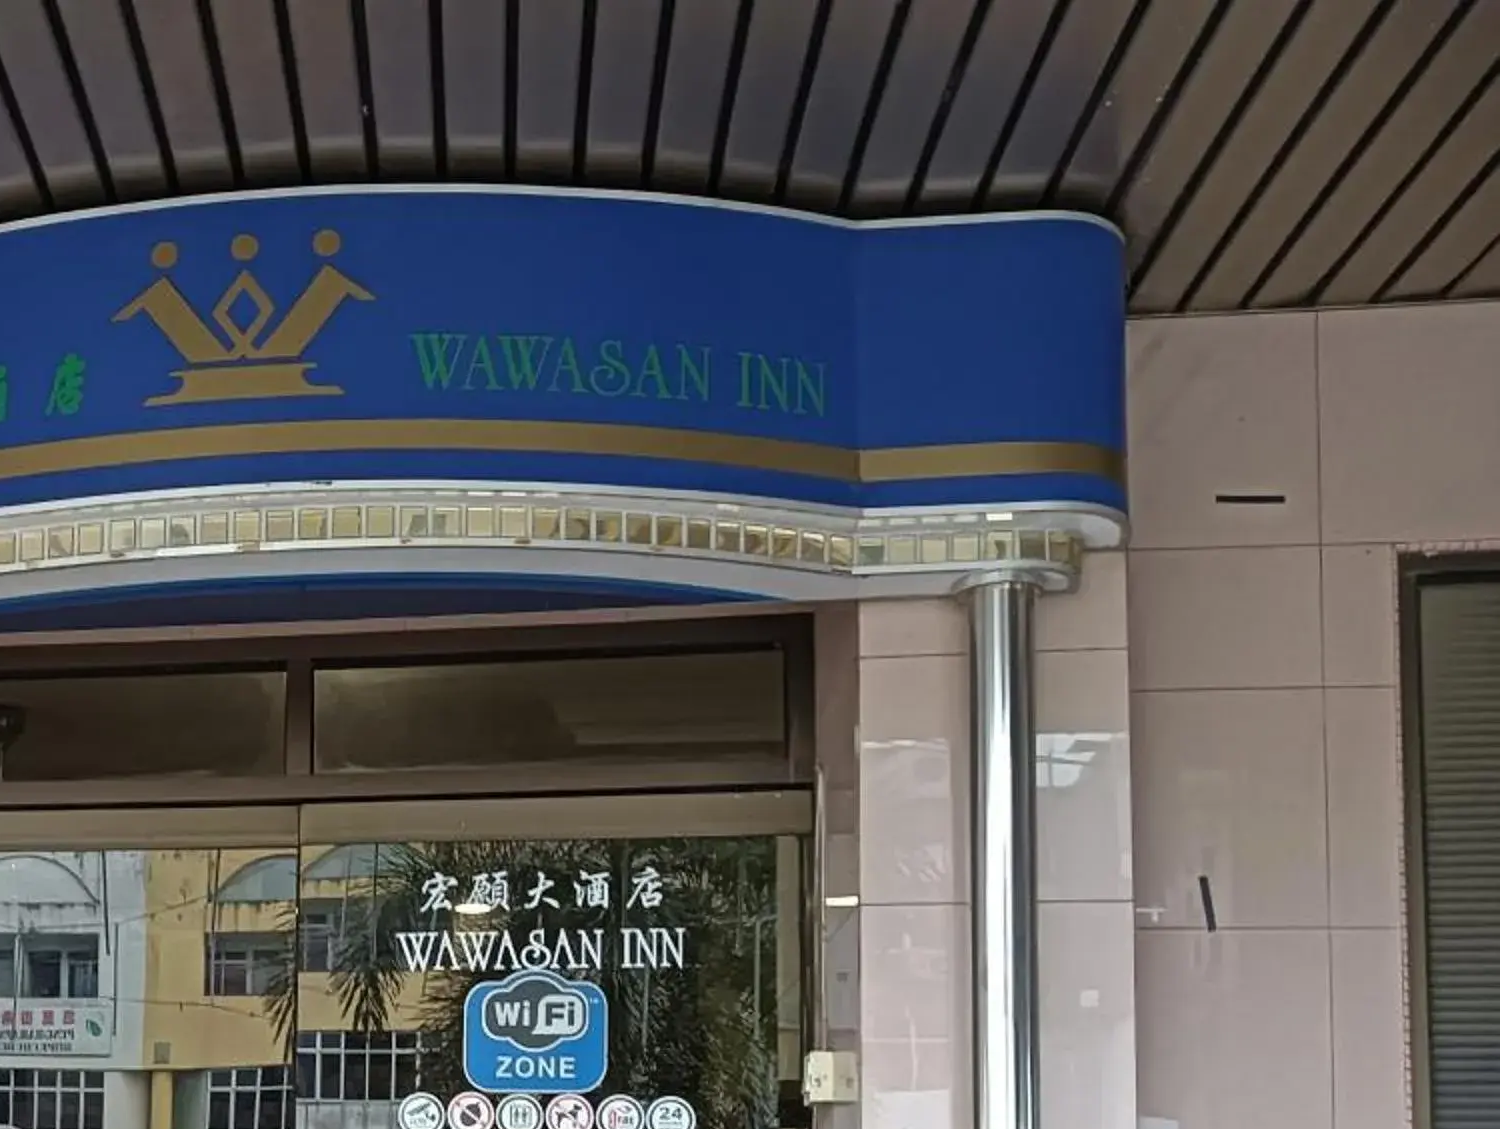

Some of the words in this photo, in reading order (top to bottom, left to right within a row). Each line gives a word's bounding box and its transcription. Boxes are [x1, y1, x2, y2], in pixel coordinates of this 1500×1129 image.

[409, 331, 713, 401] WAWASAN
[737, 351, 828, 417] INN
[396, 928, 604, 972] WAWASAN
[621, 927, 688, 970] INN
[495, 1055, 577, 1079] ZONE
[659, 1106, 683, 1121] 24
